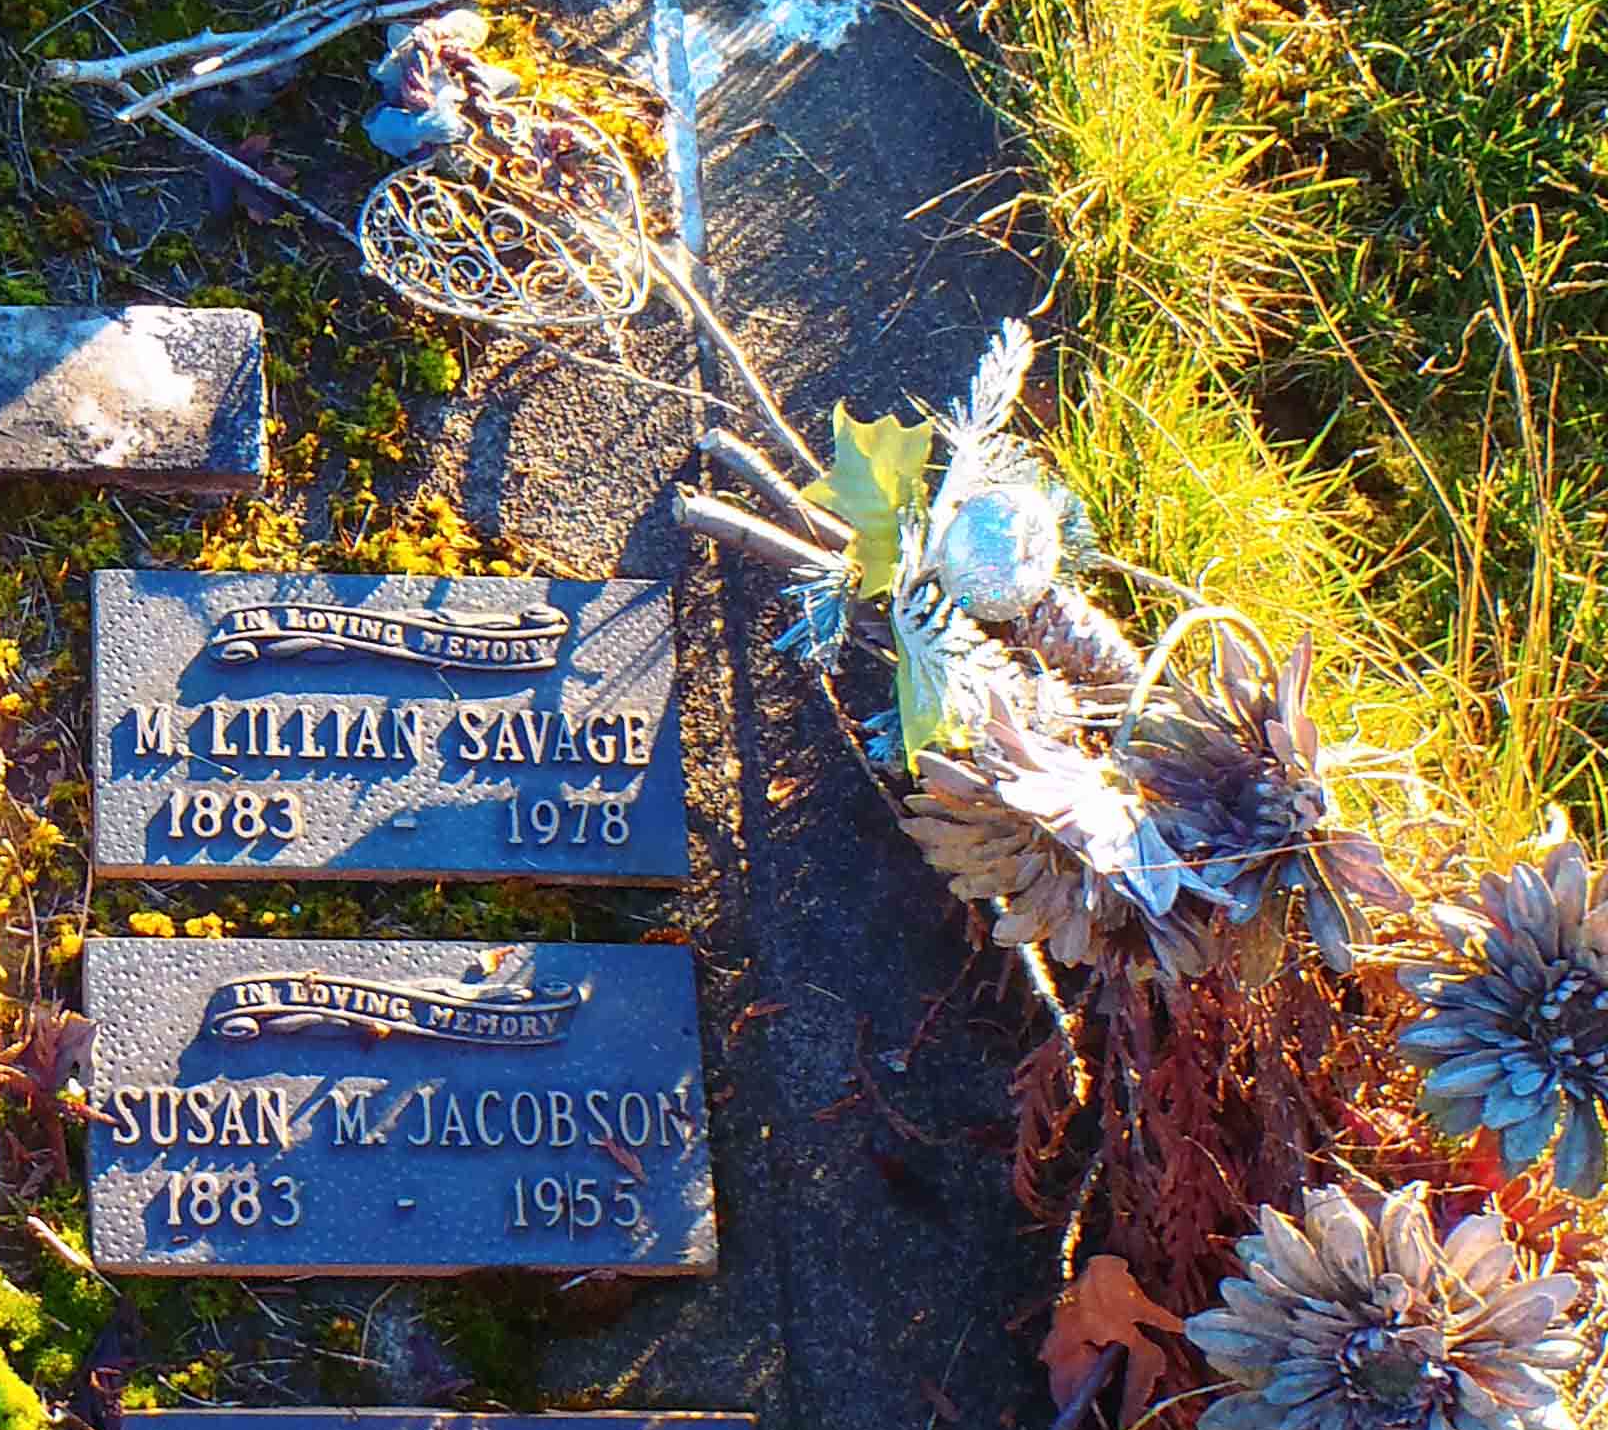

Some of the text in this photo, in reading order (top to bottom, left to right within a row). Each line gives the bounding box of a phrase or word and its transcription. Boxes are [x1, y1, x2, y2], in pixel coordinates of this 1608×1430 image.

[234, 609, 558, 661] IN LOVING MEMORY
[133, 705, 650, 764] M. LILLIAN SAVAGE
[166, 789, 304, 839] 1883
[508, 797, 629, 844] 1978
[235, 981, 562, 1037] IN LOVING MEMORY
[113, 1087, 691, 1147] SUSAN M. JACOBSON
[166, 1174, 300, 1227] 1883
[513, 1179, 641, 1227] 1955
